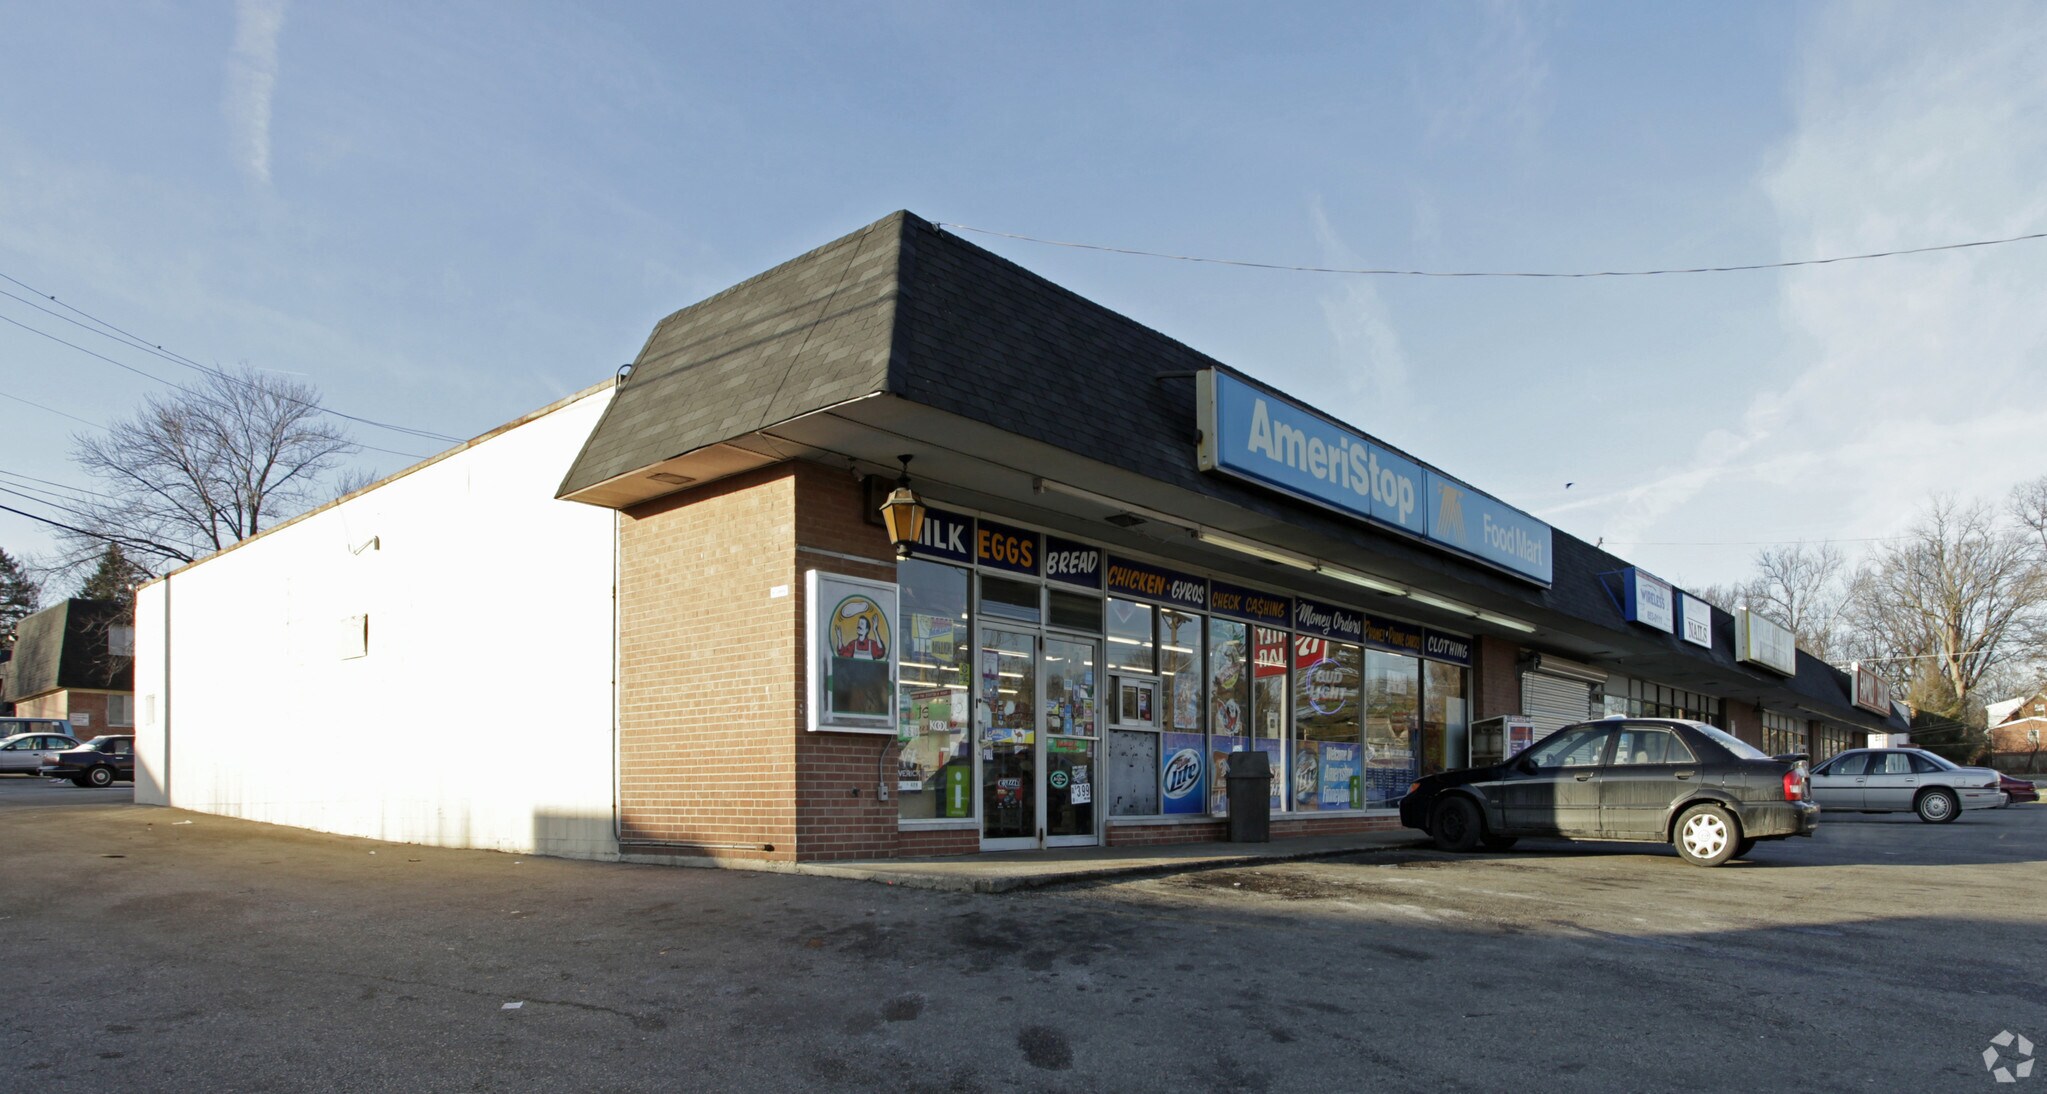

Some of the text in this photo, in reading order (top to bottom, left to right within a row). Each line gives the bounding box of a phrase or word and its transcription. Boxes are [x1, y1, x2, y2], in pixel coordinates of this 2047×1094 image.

[1248, 398, 1414, 525] AmeriStop
[919, 517, 967, 554] ILK
[977, 529, 1033, 568] EGGS
[1484, 514, 1543, 566] Food Mart
[1047, 551, 1099, 575] BREAD
[1107, 565, 1205, 604] CHICKEN GYROS
[1212, 592, 1242, 611] CHECK
[1296, 601, 1362, 636] Money Orders
[1687, 621, 1708, 645] NAILS
[1428, 636, 1468, 658] CLOTHING
[929, 720, 949, 732] KOOL
[1169, 763, 1197, 792] Lite
